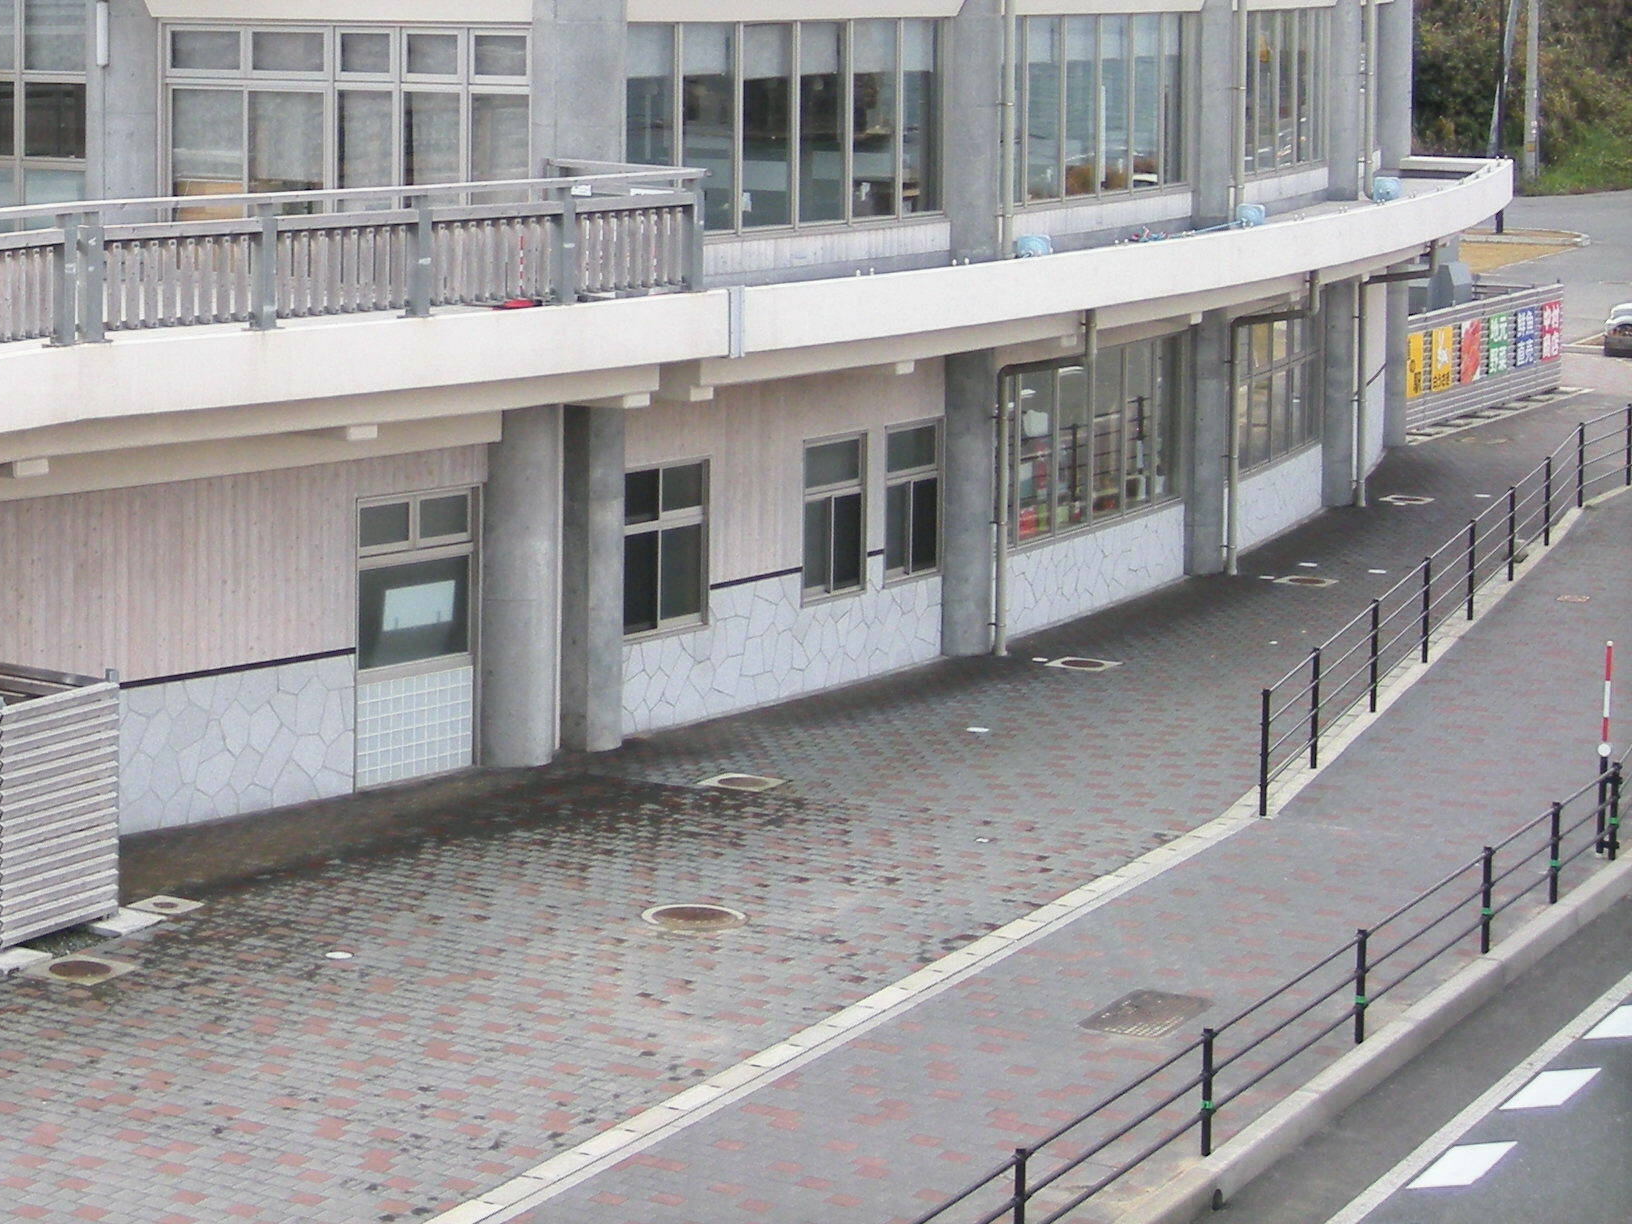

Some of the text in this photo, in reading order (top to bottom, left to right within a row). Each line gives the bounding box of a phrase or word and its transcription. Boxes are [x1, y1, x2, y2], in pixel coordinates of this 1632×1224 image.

[1490, 317, 1508, 342] 地元
[1517, 310, 1534, 337] 鮮魚
[1489, 346, 1507, 374] 野菜
[1517, 339, 1534, 366] 直売
